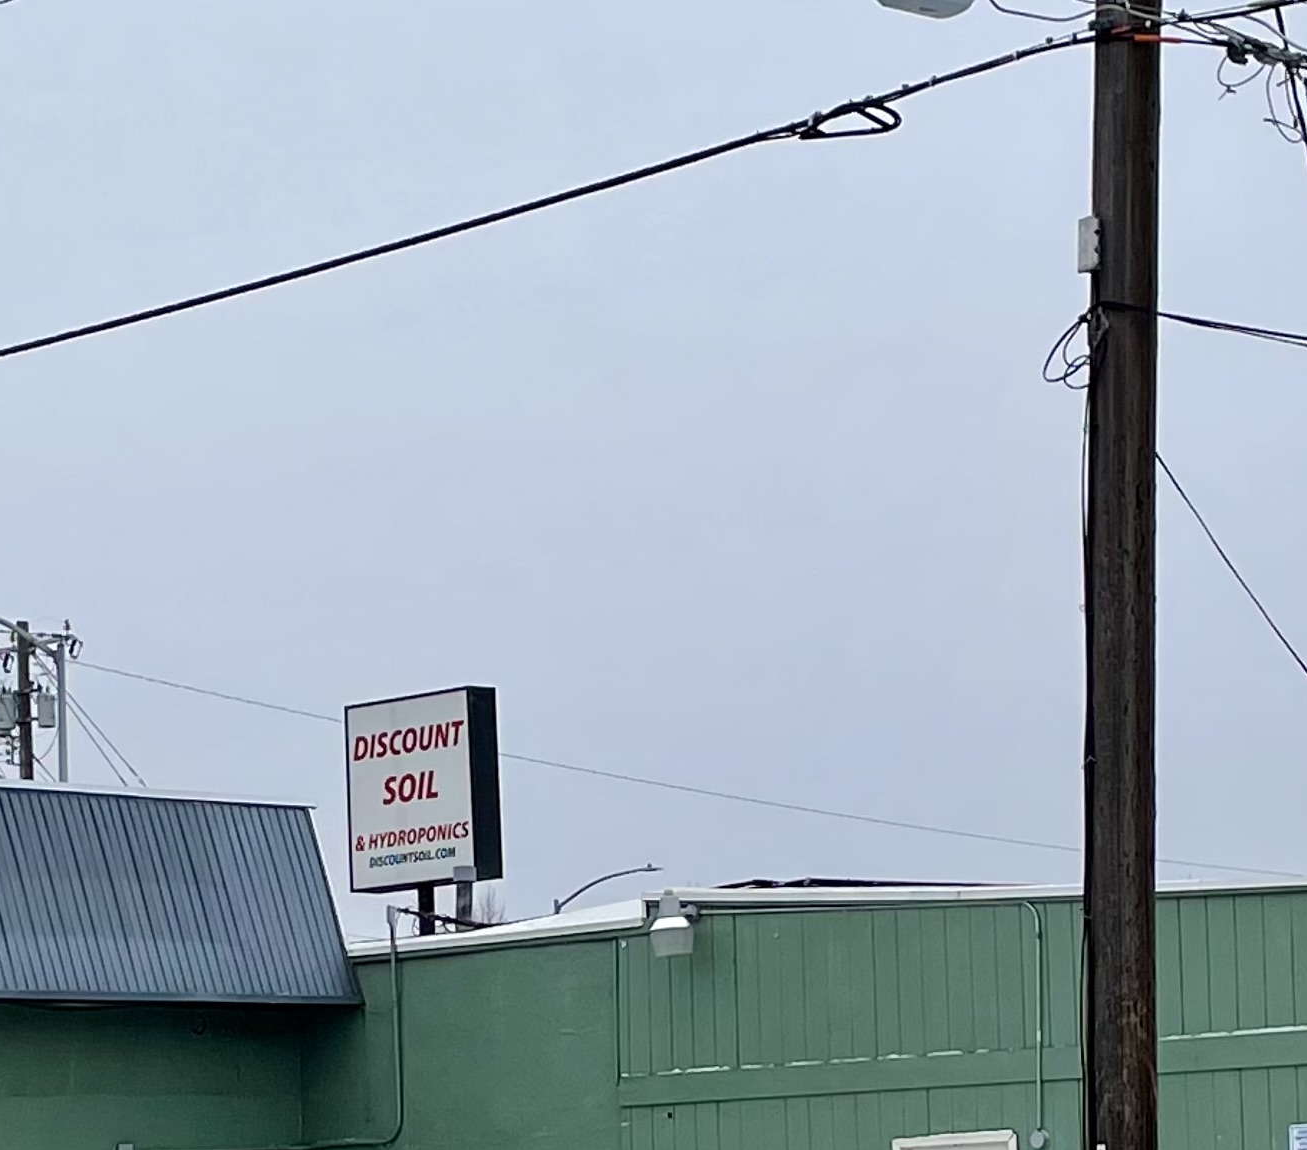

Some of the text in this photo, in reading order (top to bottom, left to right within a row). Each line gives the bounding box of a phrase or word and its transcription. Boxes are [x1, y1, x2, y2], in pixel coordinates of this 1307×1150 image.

[353, 720, 464, 761] DISCOUNT
[383, 770, 438, 805] SOIL
[355, 821, 469, 852] & HYDROPONICS
[369, 847, 456, 868] DISCOUNTSOIL.COM
